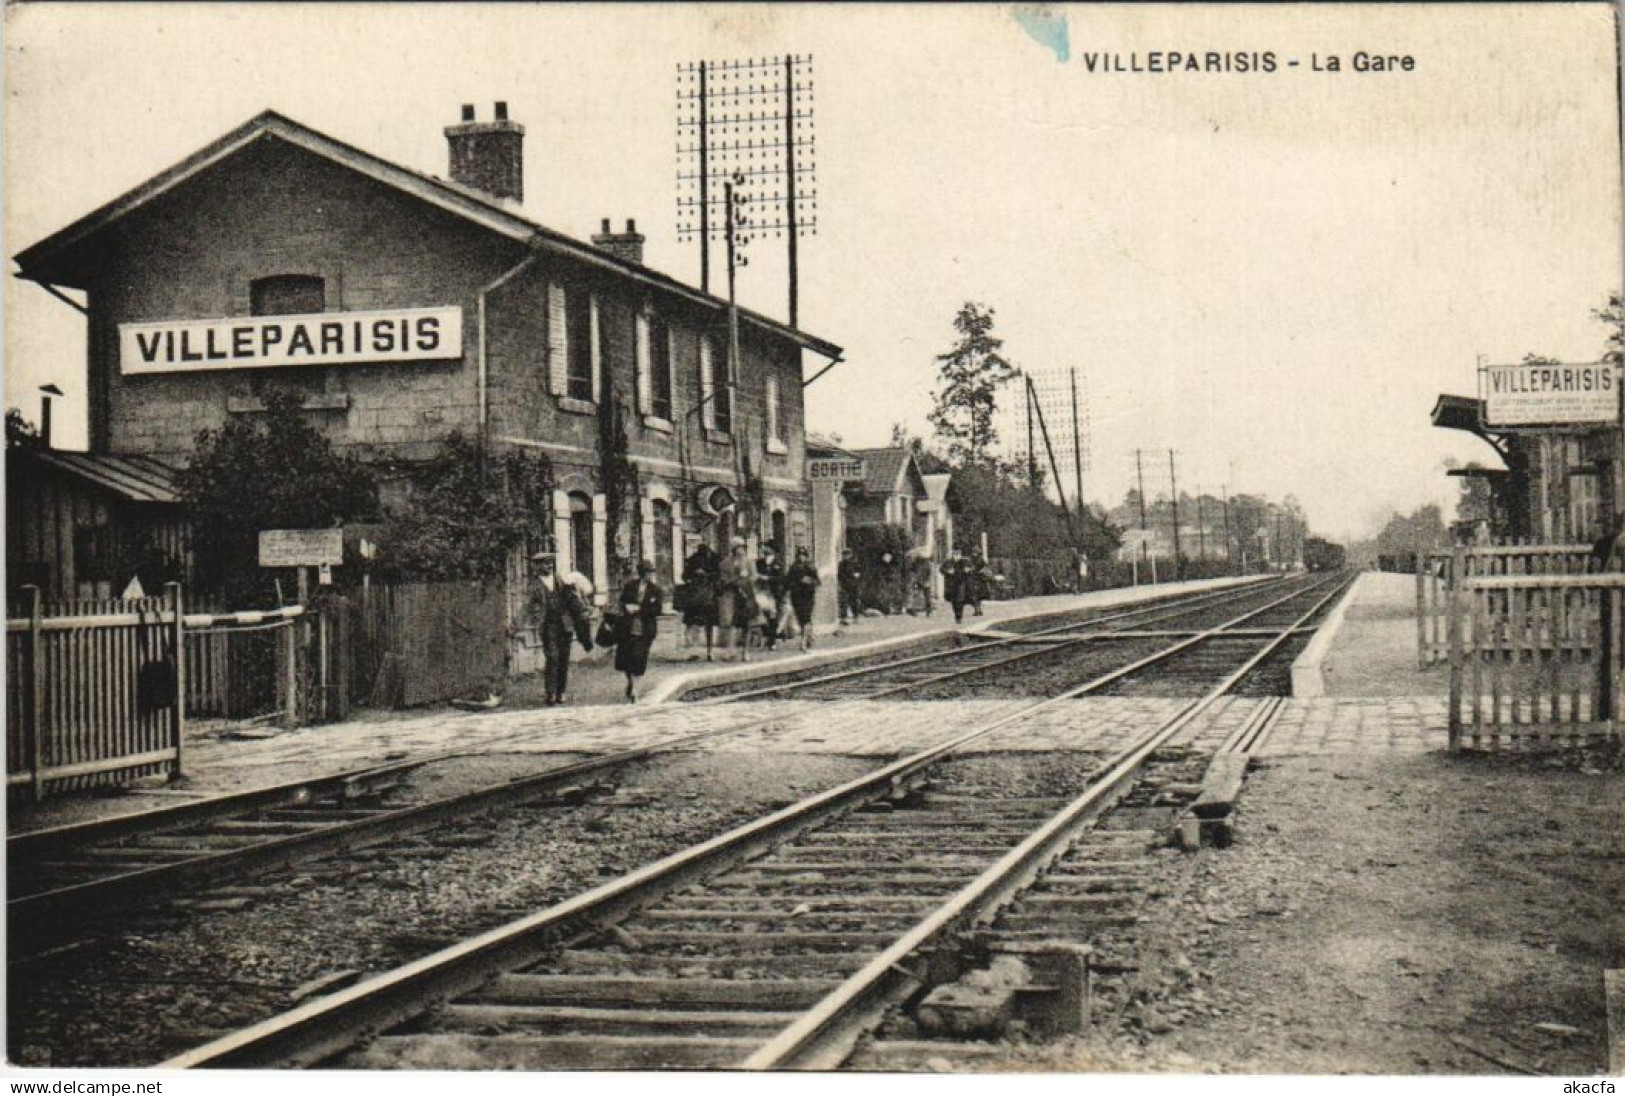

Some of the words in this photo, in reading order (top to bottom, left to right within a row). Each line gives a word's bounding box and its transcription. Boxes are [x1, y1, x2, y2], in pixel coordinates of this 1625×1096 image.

[136, 317, 440, 363] VILLEPARISIS
[1492, 368, 1612, 393] VILLEPARISIS
[811, 460, 861, 478] SORTIE
